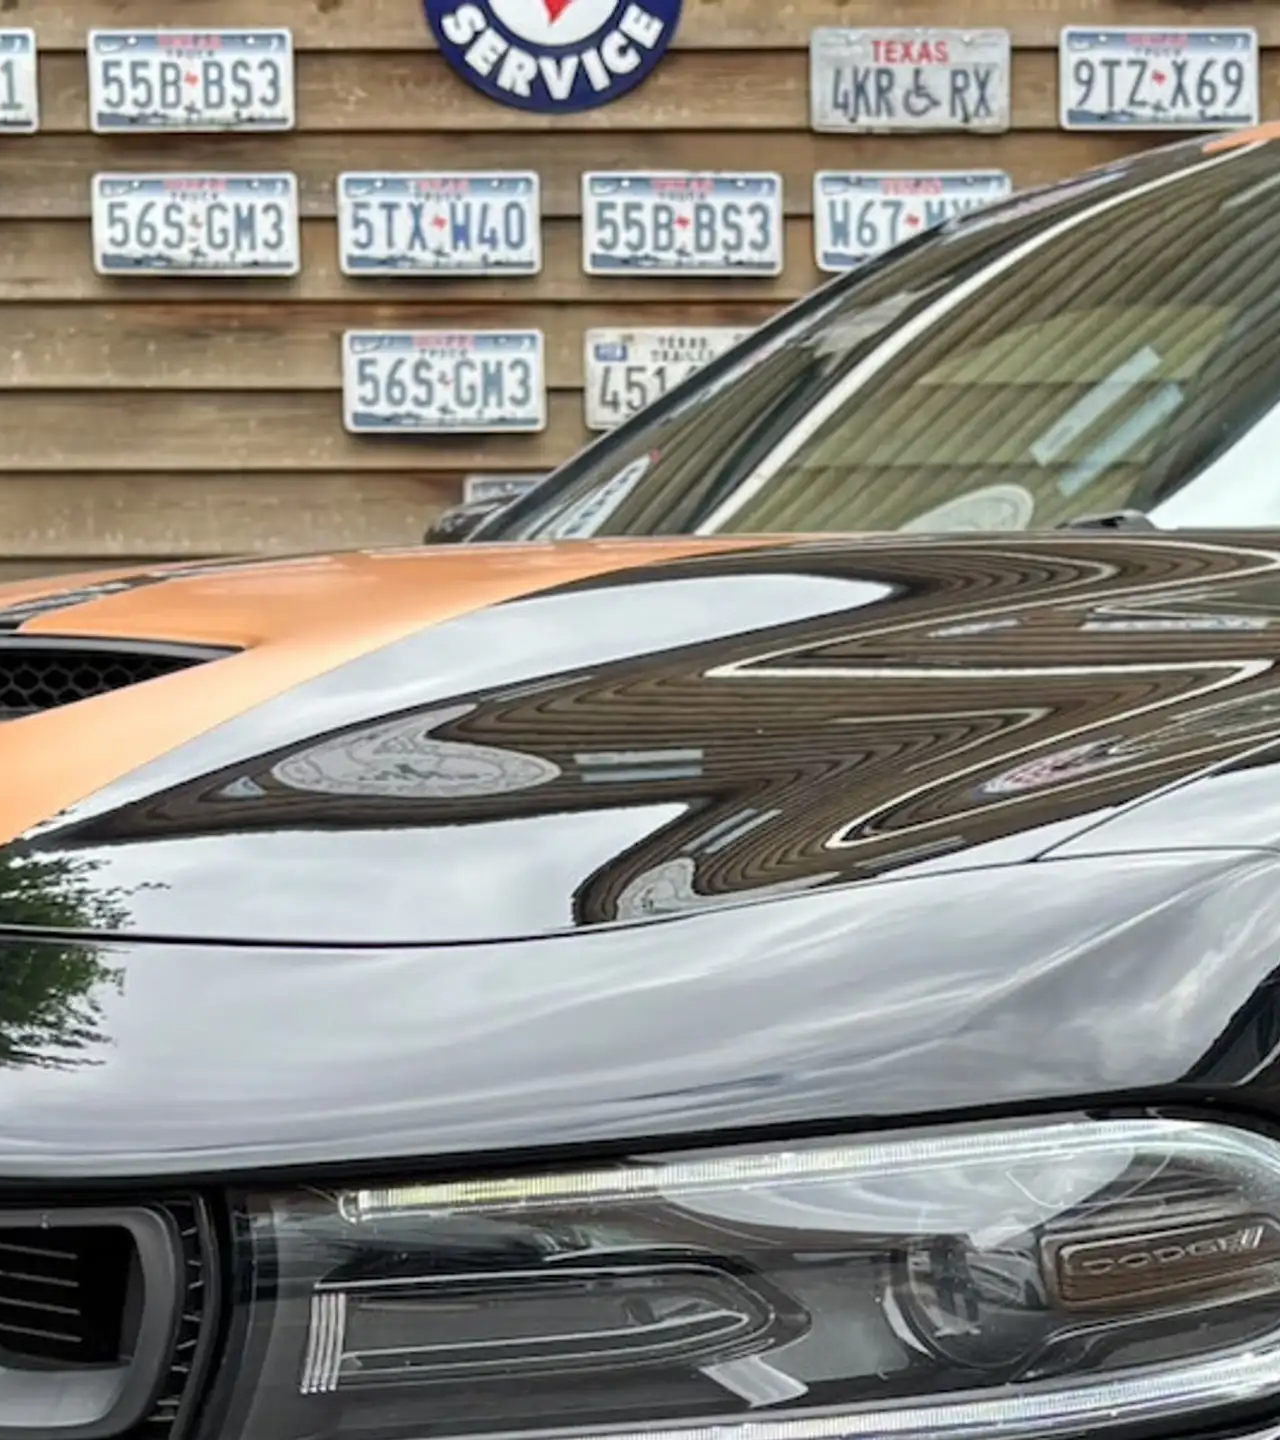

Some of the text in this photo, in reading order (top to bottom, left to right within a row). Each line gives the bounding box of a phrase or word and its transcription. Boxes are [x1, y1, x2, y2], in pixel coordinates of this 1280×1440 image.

[441, 3, 665, 100] SERVICE
[872, 40, 949, 63] TEXAS
[101, 60, 280, 109] 55B BS3
[832, 66, 992, 118] 4KR RX
[1073, 59, 1244, 109] 9TZ X69
[107, 201, 284, 251] 56S GM3
[596, 202, 770, 253] 55B BS3
[828, 200, 903, 248] W67
[357, 357, 531, 408] 56S GM3
